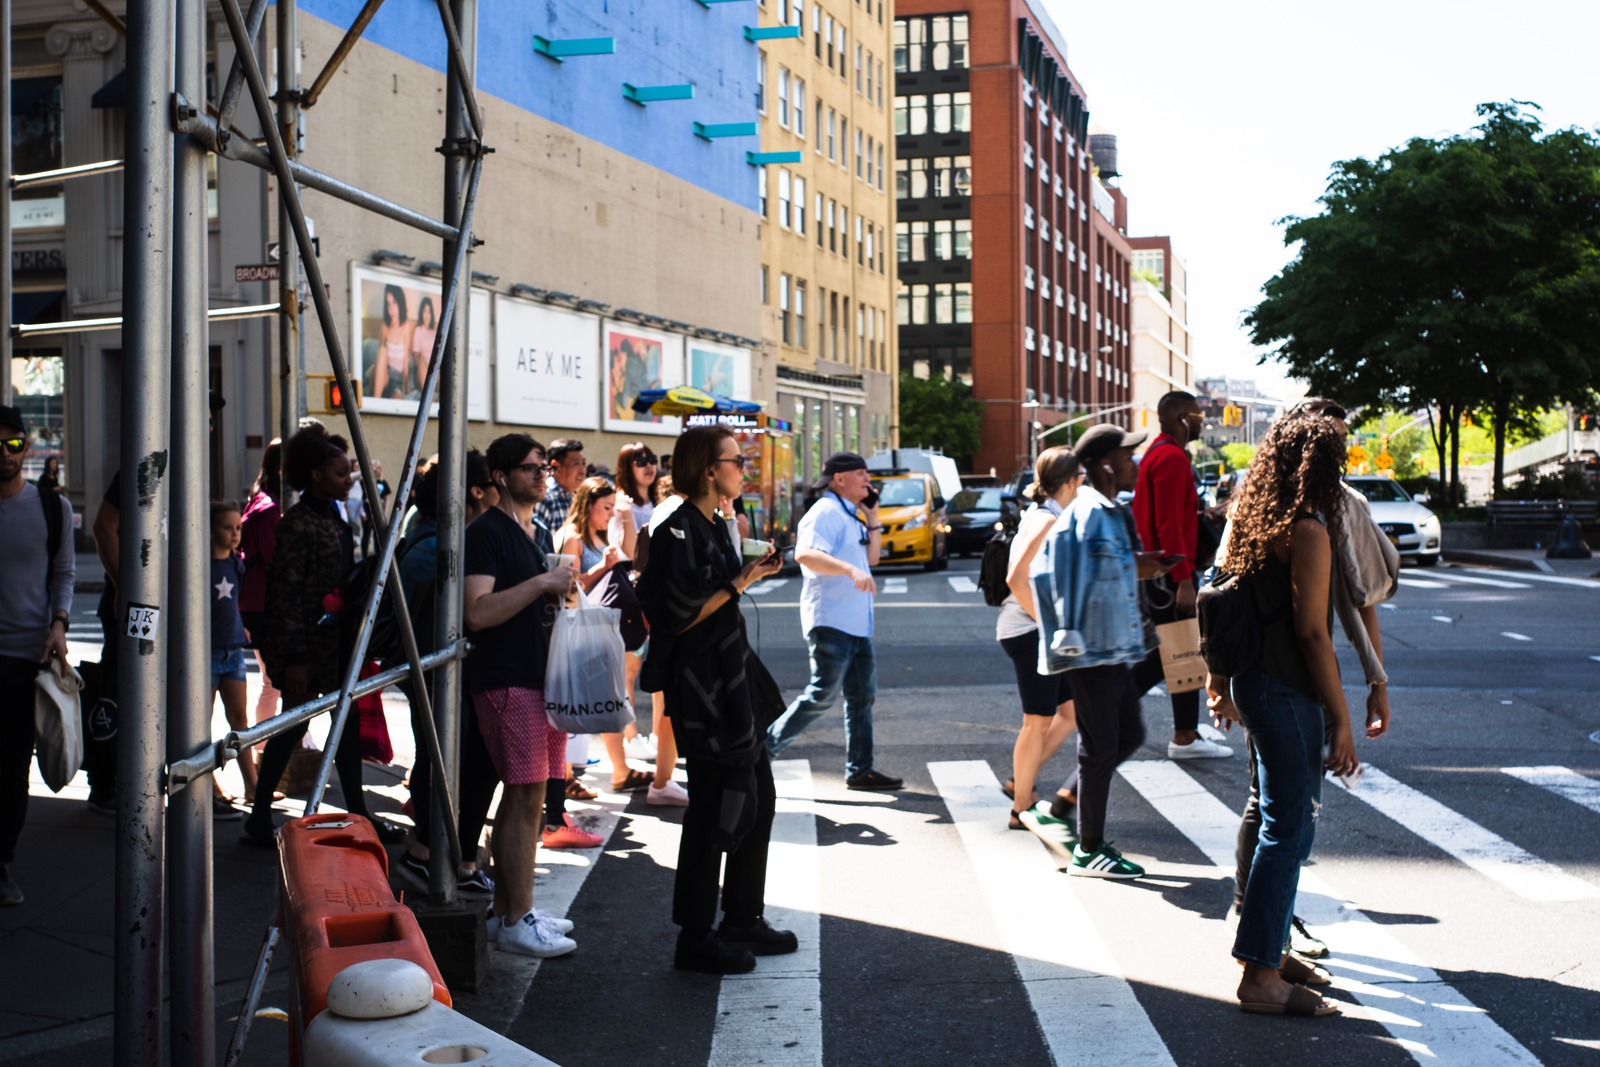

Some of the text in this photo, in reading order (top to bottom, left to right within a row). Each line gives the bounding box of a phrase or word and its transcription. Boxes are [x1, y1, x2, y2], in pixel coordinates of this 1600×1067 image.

[236, 267, 279, 281] BROADW
[516, 347, 582, 379] AE X ME
